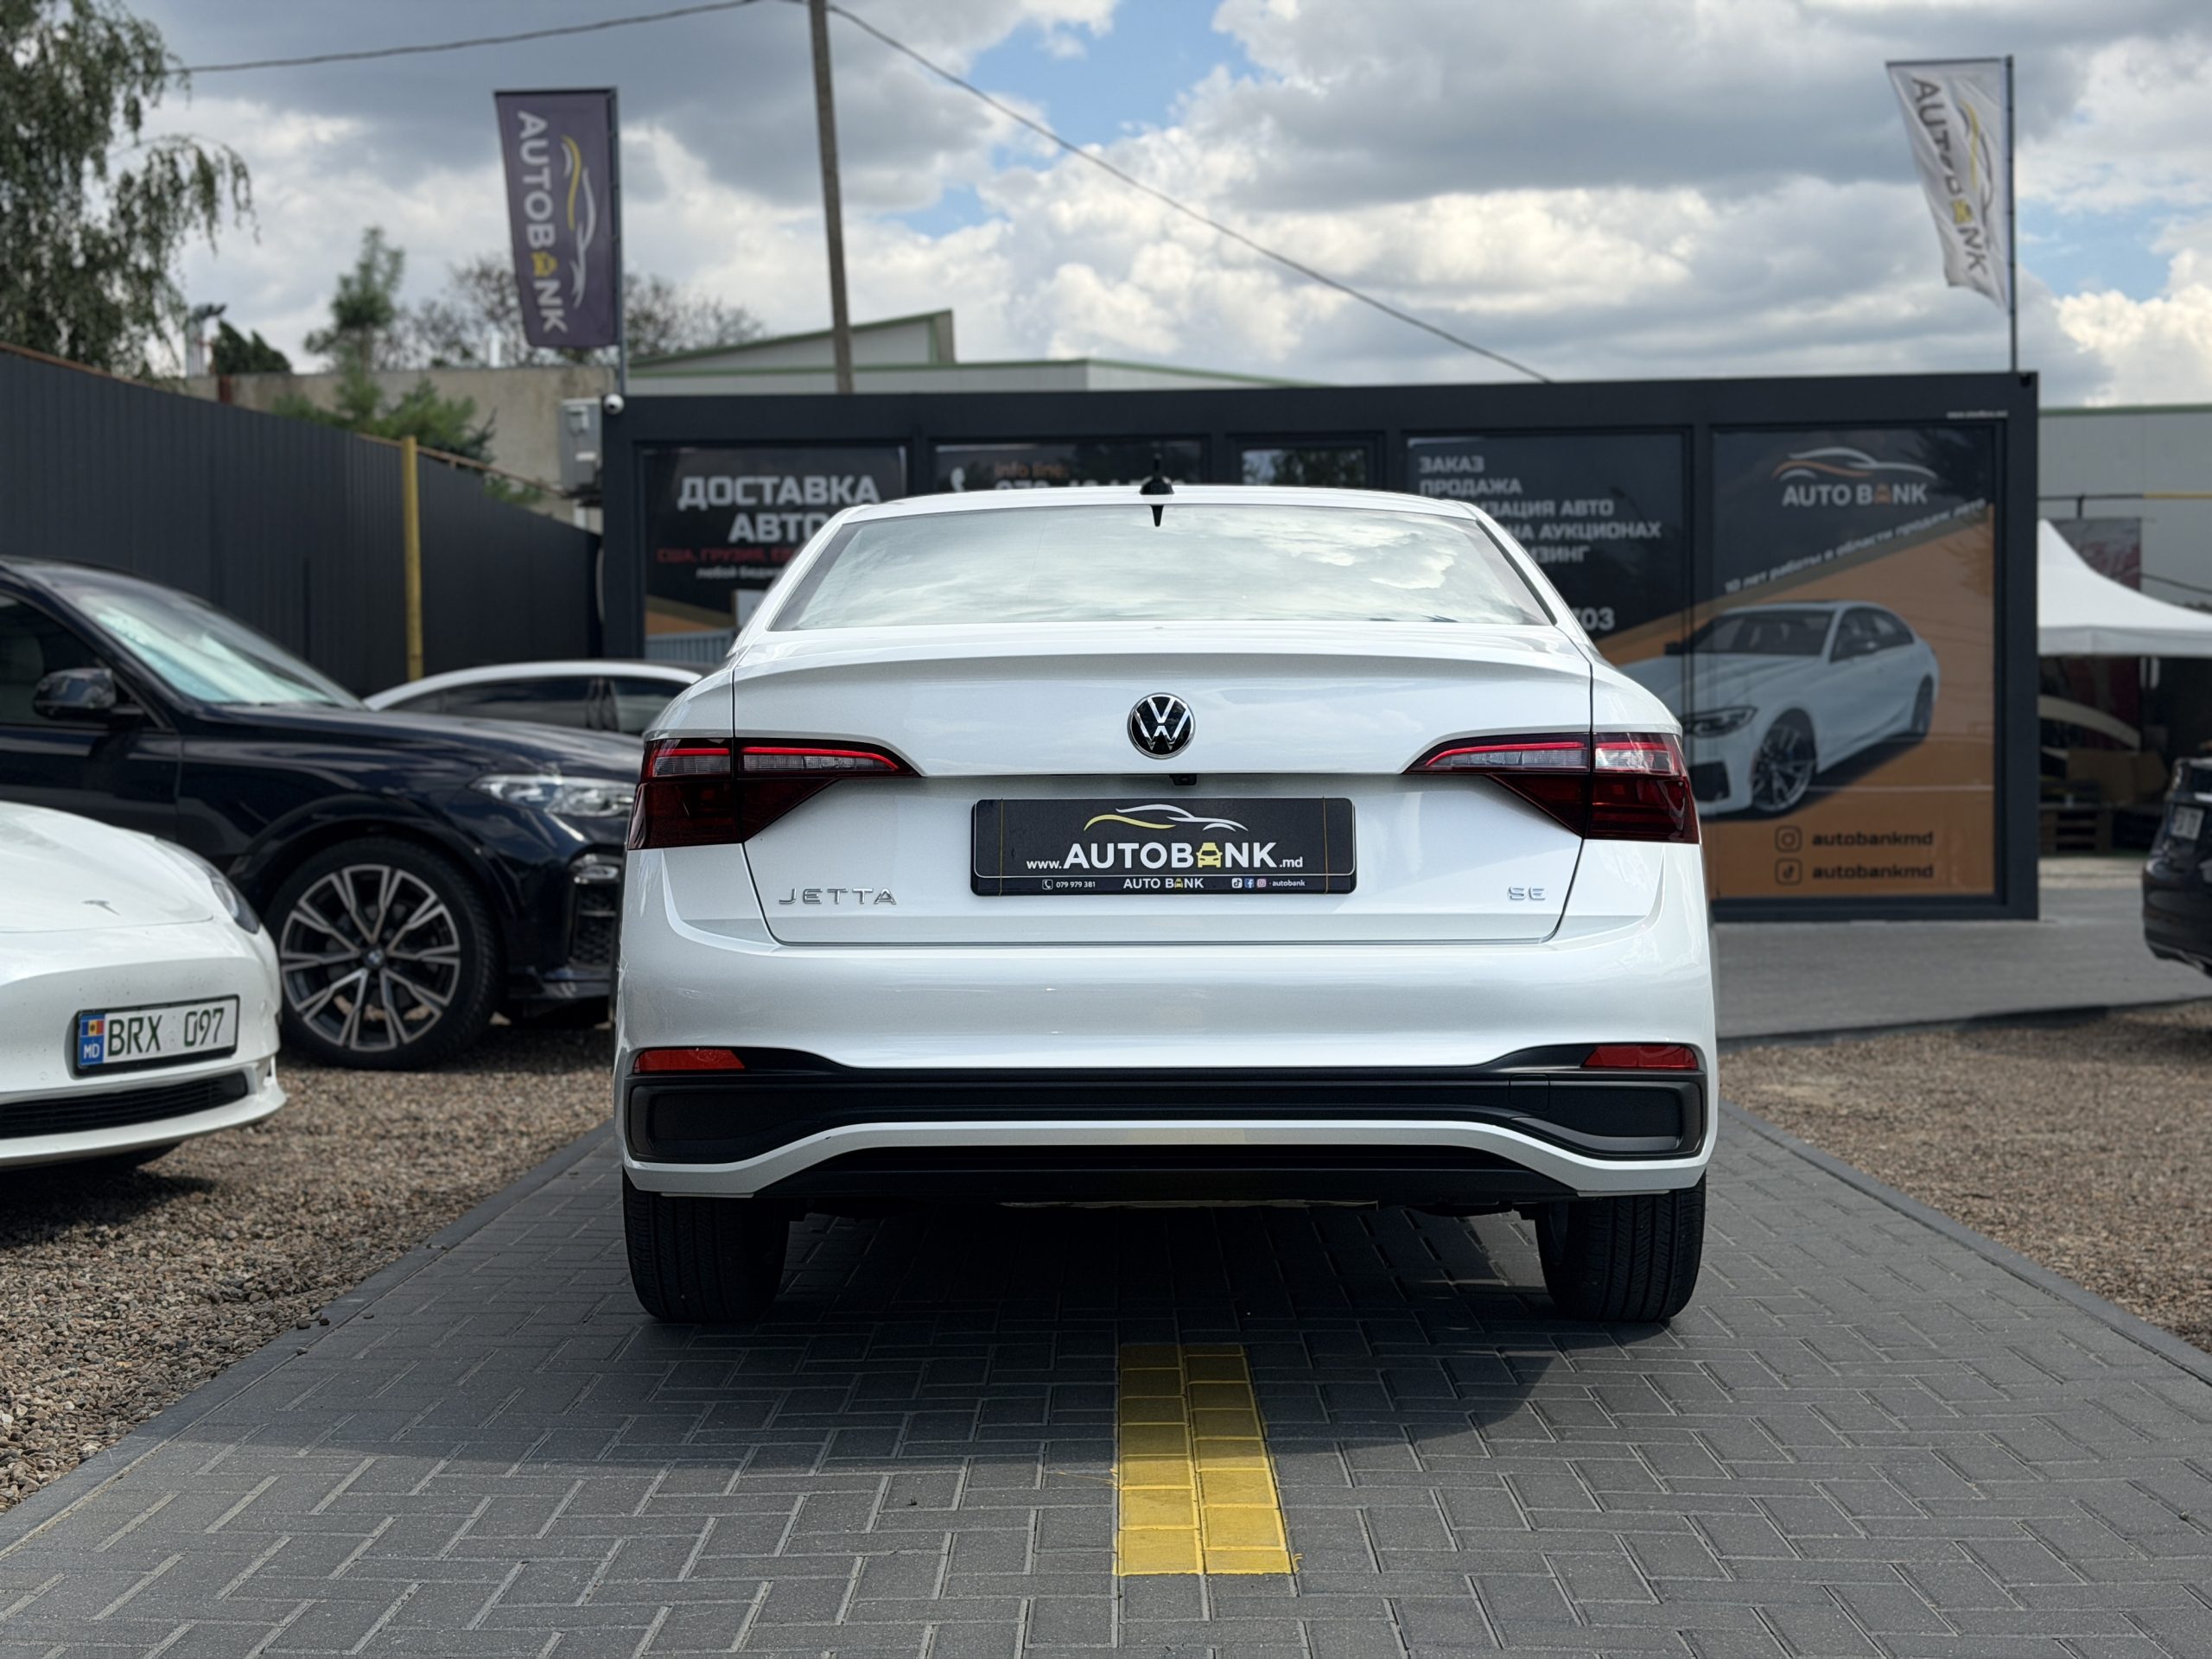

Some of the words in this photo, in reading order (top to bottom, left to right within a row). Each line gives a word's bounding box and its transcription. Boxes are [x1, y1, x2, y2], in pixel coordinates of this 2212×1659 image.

[1419, 455, 1484, 474] ЗАКАЗ
[677, 475, 880, 511] ДОСТАВКА
[1420, 479, 1522, 498] ПРОДАЖА
[1782, 485, 1851, 507] AUTO
[1560, 499, 1614, 517] АВТО
[728, 512, 830, 543] АВТО
[1538, 521, 1662, 541] АУКЦИОНАХ
[1812, 831, 1934, 847] autobankmd
[1812, 864, 1934, 879] autobankmd
[1123, 878, 1160, 889] AUTO
[1166, 878, 1205, 888] BANK
[779, 887, 897, 905] JETTA
[1508, 887, 1546, 900] SE
[107, 1014, 162, 1058] BRX
[184, 1007, 225, 1047] 097
[83, 1043, 99, 1059] MD
